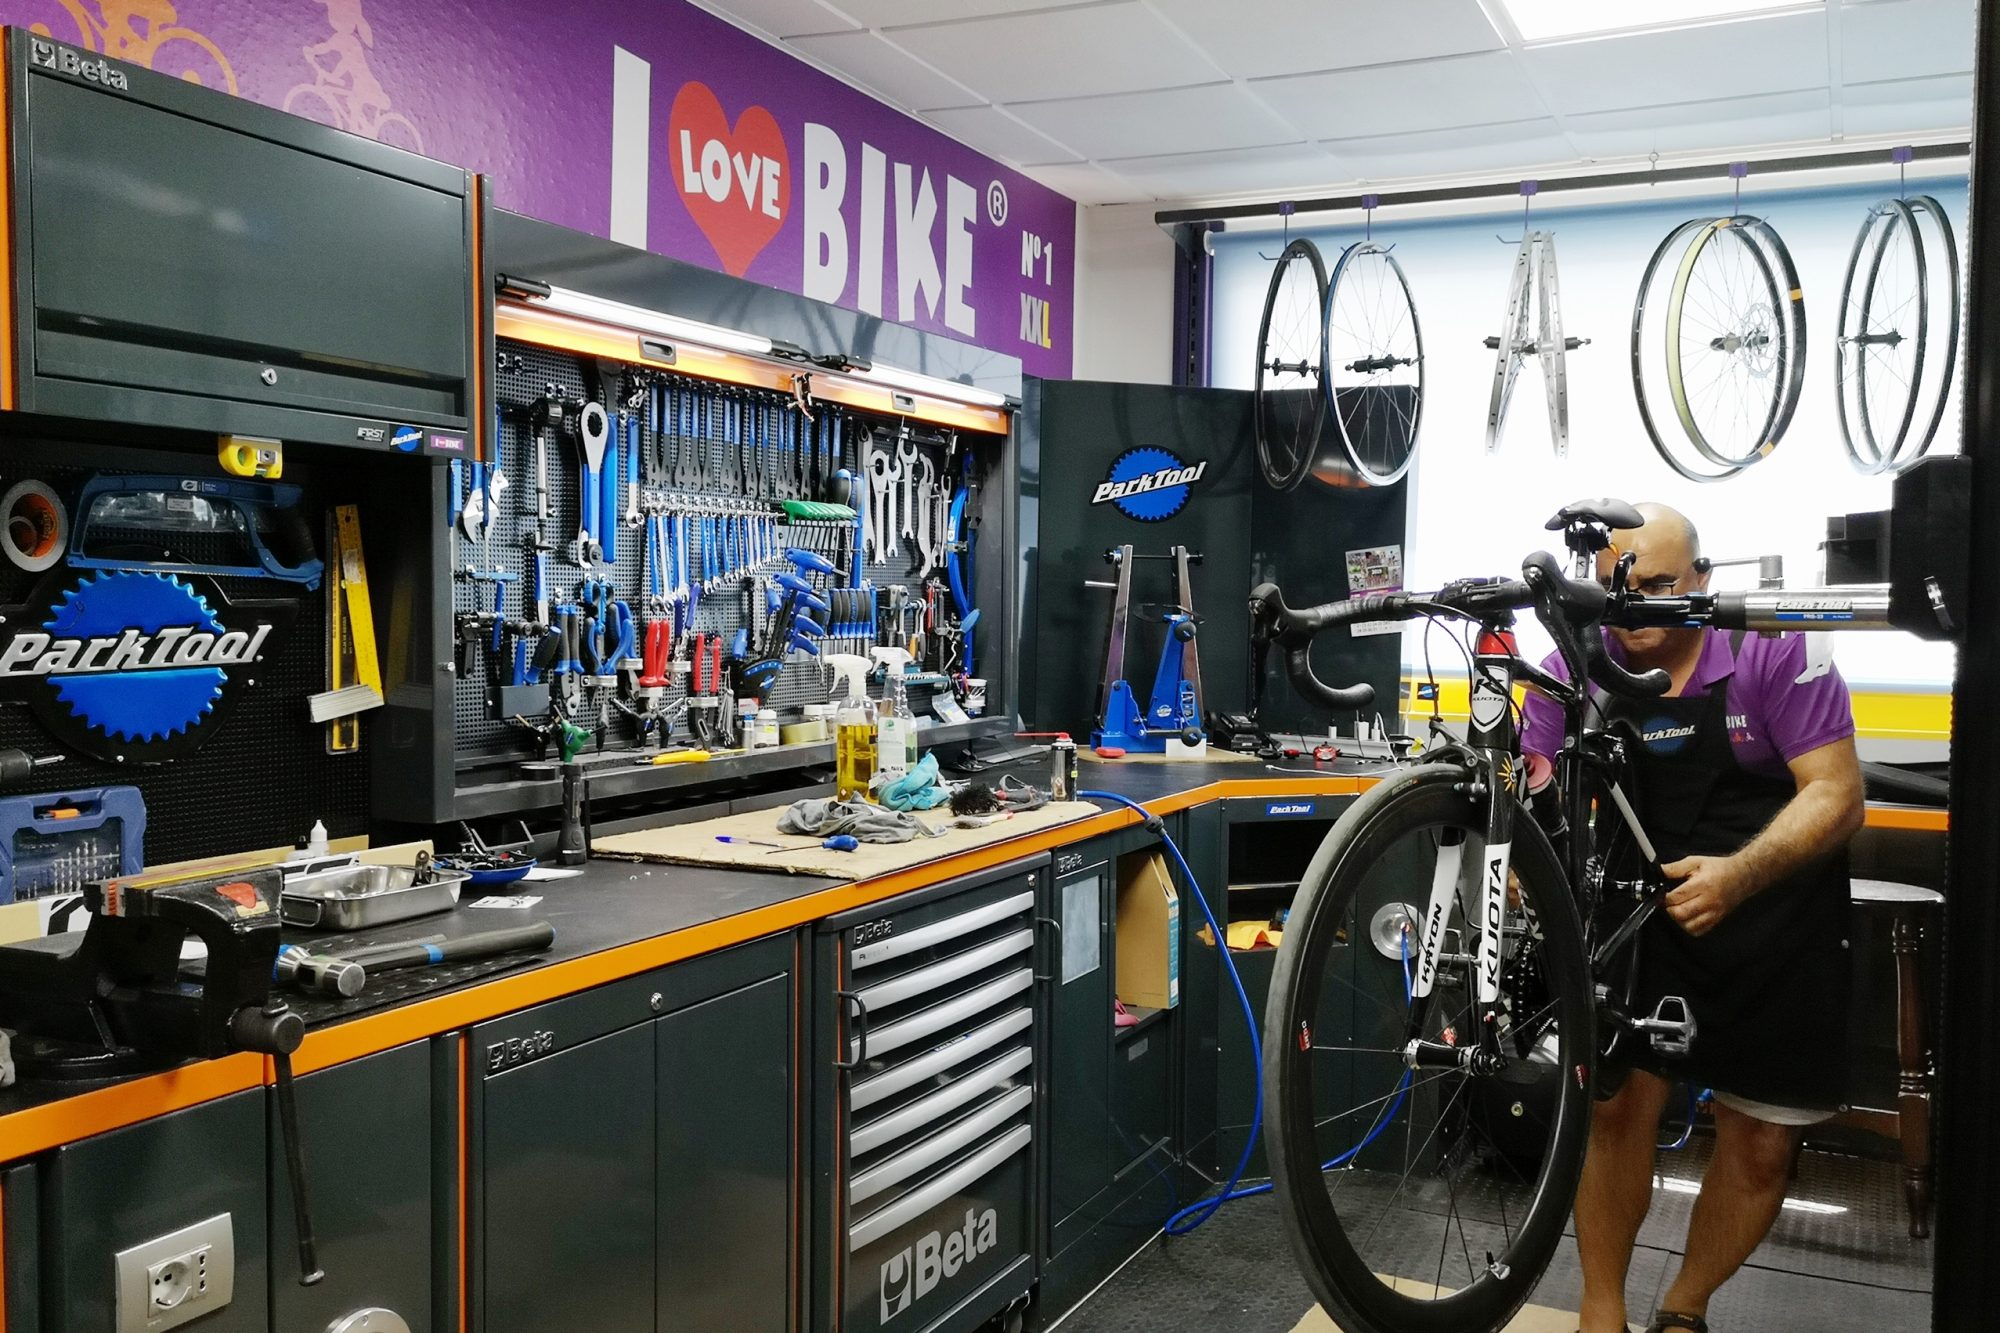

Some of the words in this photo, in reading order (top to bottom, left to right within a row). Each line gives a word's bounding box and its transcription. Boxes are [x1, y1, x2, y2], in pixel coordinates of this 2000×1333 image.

[59, 46, 128, 91] Beta
[610, 44, 651, 250] I
[680, 129, 781, 220] LOVE
[803, 122, 977, 338] BIKE
[1044, 242, 1053, 286] 1
[1020, 292, 1052, 349] XXL
[1422, 903, 1442, 984] KRYON
[1487, 858, 1502, 988] KUOTA
[505, 1030, 554, 1063] Beta
[915, 1207, 997, 1301] Beta
